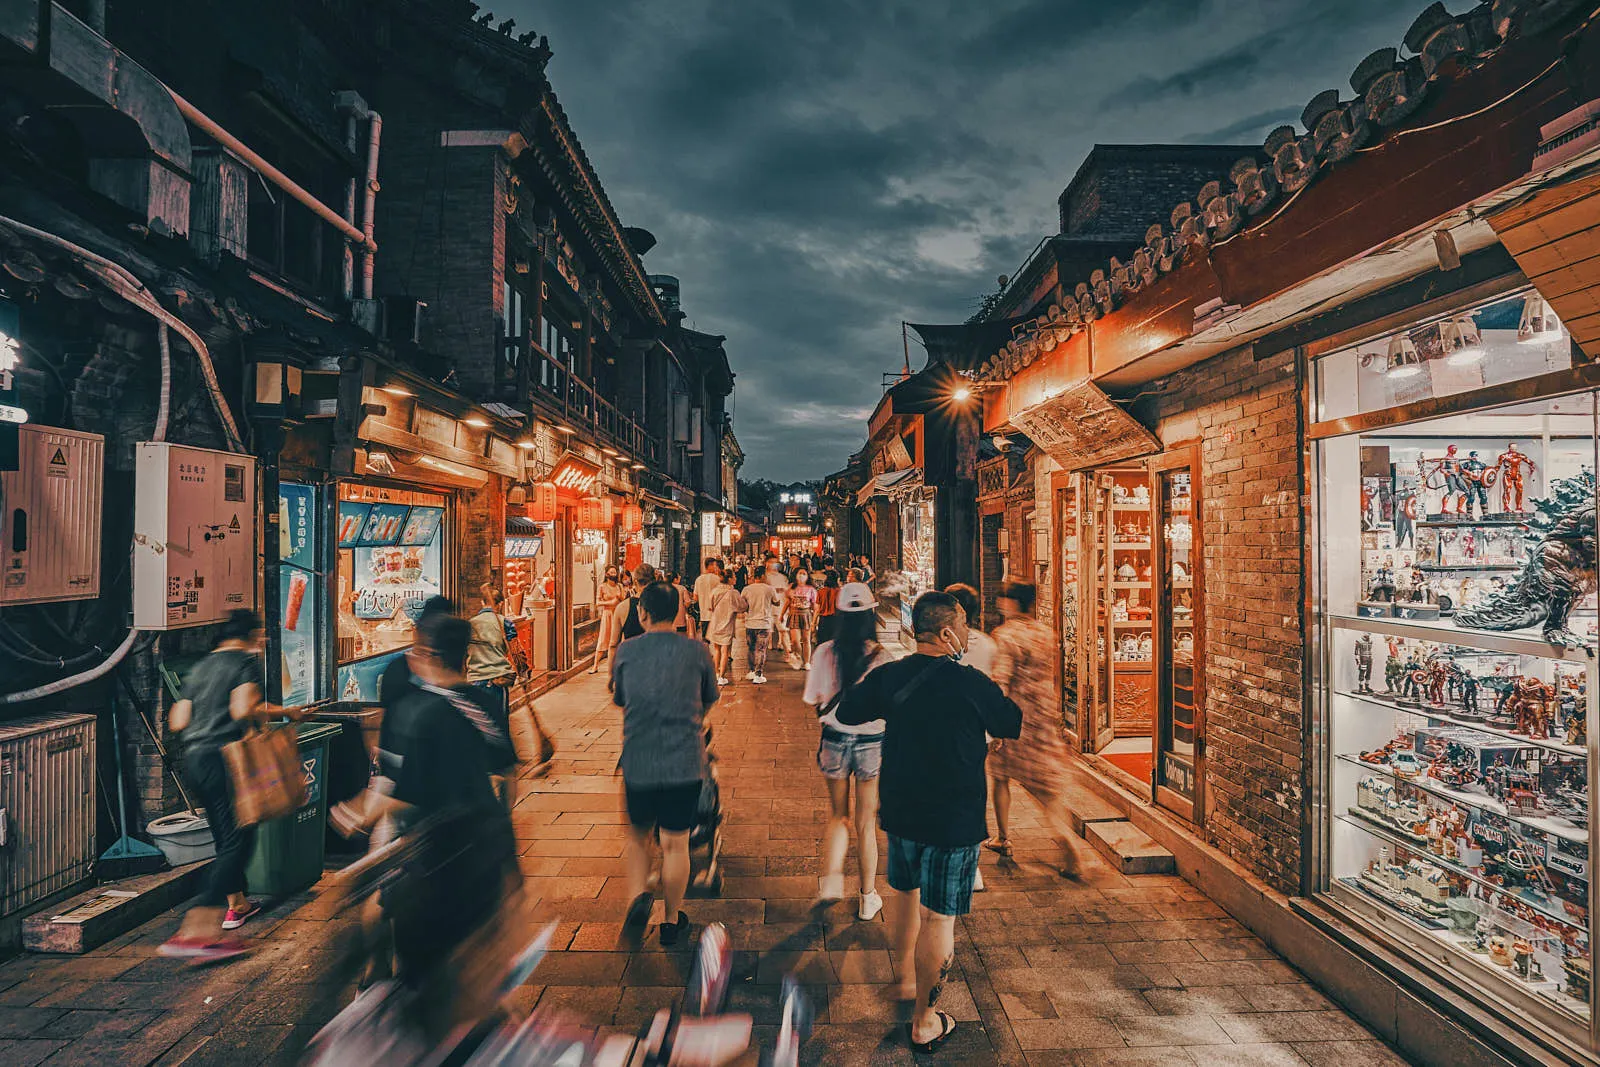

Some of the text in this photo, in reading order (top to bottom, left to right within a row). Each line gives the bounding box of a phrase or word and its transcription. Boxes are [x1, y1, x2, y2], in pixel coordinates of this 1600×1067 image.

[359, 587, 424, 612] 饮冰吧
[1186, 768, 1194, 791] te
